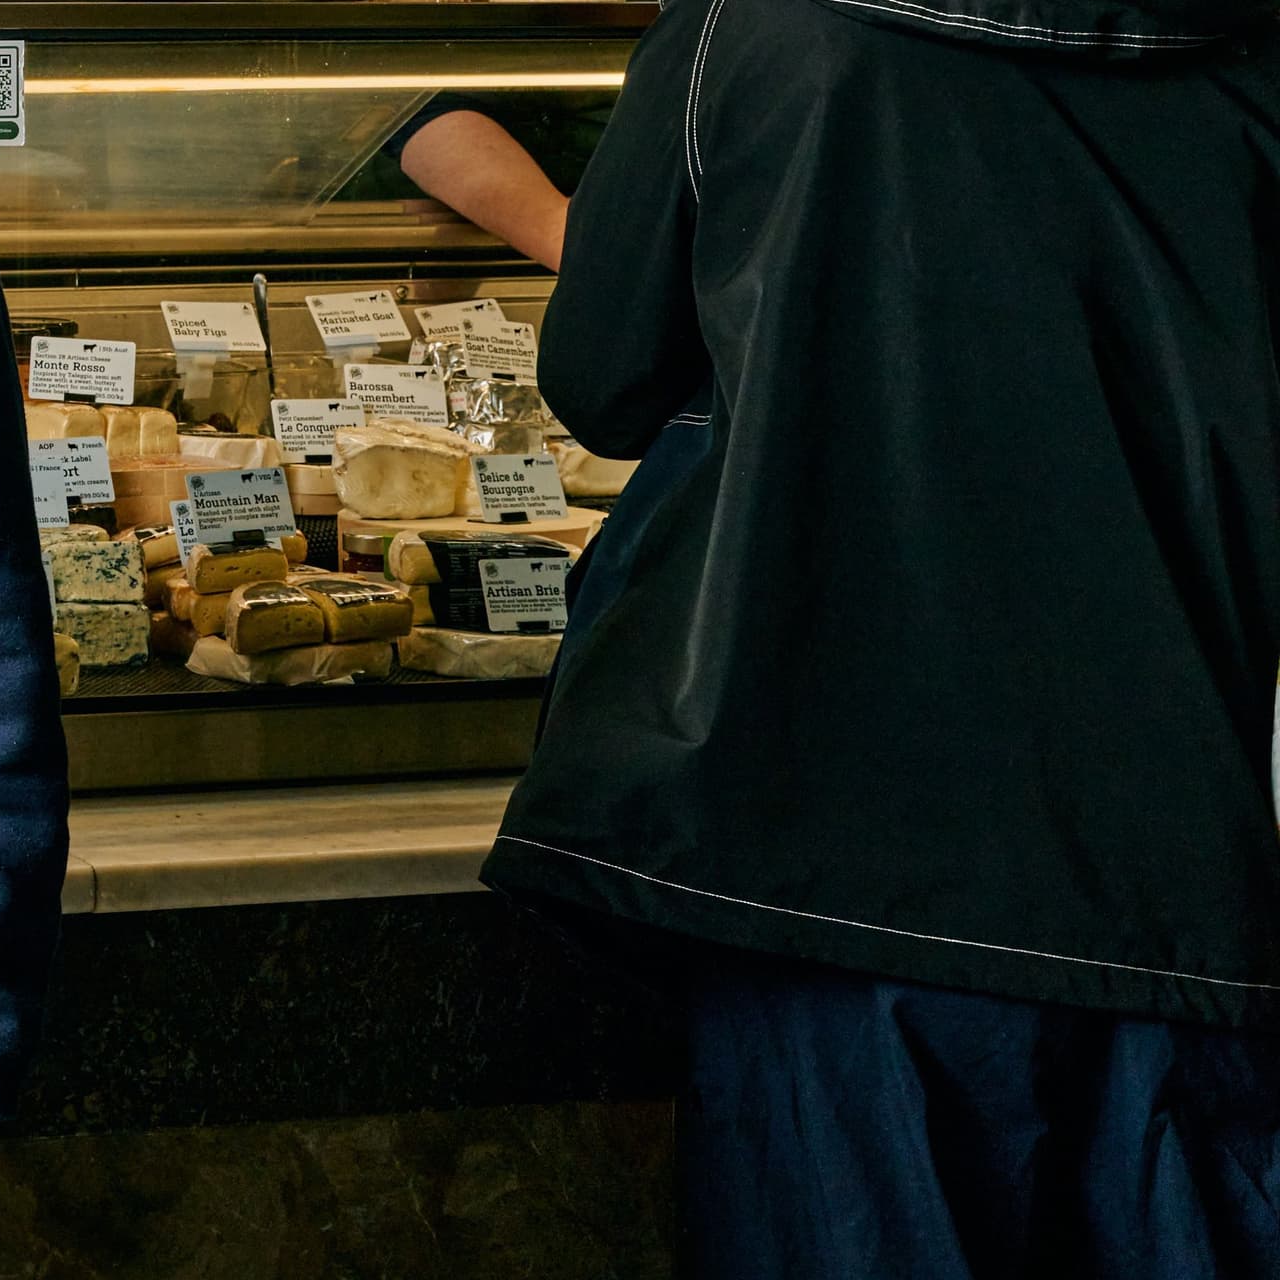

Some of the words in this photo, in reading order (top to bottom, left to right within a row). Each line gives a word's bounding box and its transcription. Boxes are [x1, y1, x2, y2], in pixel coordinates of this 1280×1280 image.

[171, 319, 206, 328] Spiced
[320, 313, 370, 325] Marinated
[372, 313, 395, 321] Goat
[174, 328, 200, 337] Baby
[204, 328, 227, 337] Figs
[324, 326, 350, 334] Fetta
[34, 360, 69, 371] Monte
[73, 362, 105, 373] Rosso
[350, 382, 393, 391] Barossa
[480, 473, 510, 483] Delice
[513, 473, 524, 481] de
[482, 485, 535, 496] Bourgogne
[195, 495, 251, 509] Mountain
[255, 494, 280, 504] Man
[487, 586, 533, 598] Artisan
[536, 585, 560, 596] Brie
